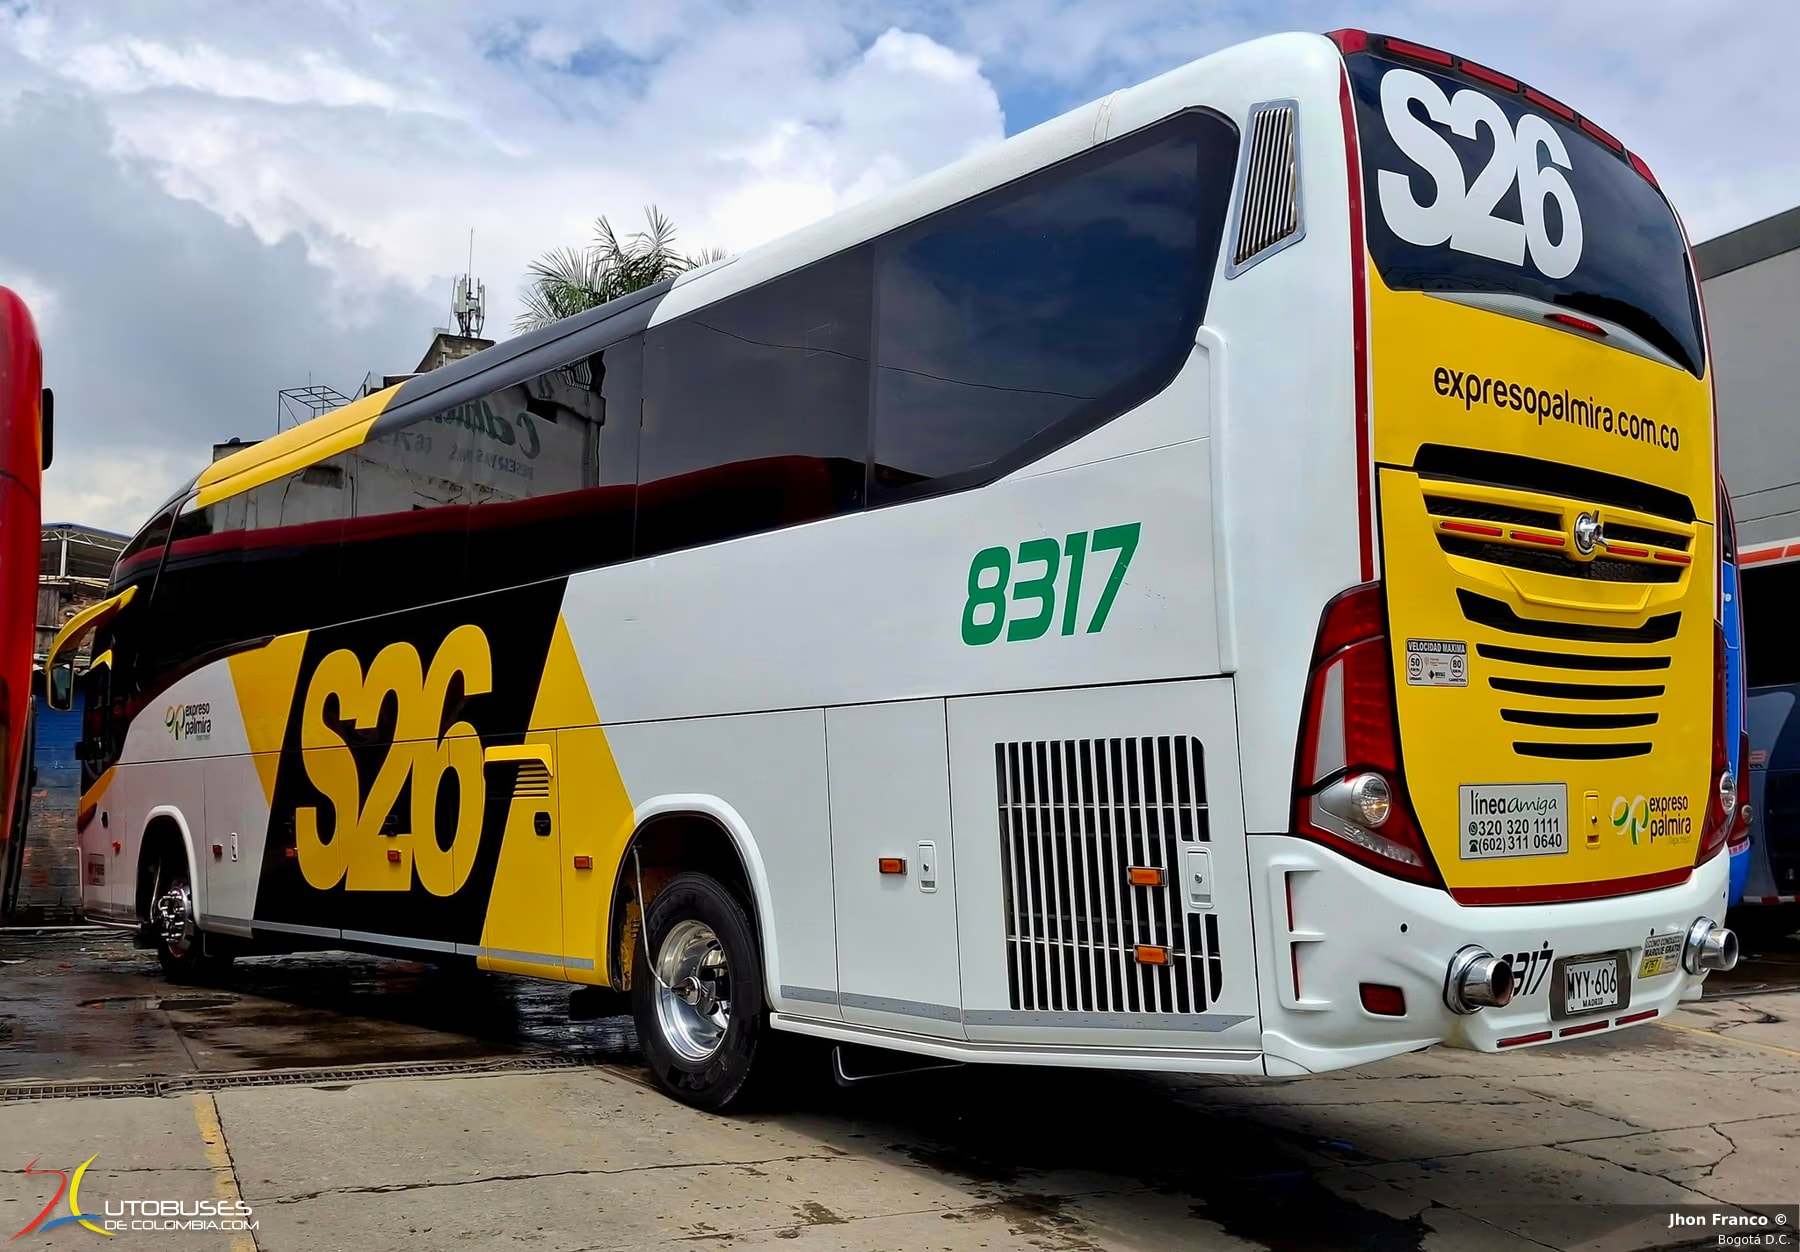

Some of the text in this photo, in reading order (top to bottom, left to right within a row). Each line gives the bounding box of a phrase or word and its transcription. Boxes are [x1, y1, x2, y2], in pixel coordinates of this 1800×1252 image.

[1377, 68, 1583, 279] S26
[1433, 366, 1680, 452] expresopalmira.com.co
[961, 522, 1141, 646] 8317
[1408, 641, 1466, 653] VELOCIDAD MAXIMA
[1410, 658, 1420, 667] 50
[1452, 659, 1462, 669] 80
[185, 703, 210, 720] expreso
[185, 718, 212, 740] palmira
[296, 624, 492, 897] S26
[1470, 789, 1558, 816] línea amiga
[1649, 795, 1689, 817] expreso
[1478, 817, 1559, 836] 320 320 1111
[1650, 813, 1692, 844] palmira
[1478, 833, 1562, 855] (602) 311 0640
[1582, 998, 1604, 1008] MADRID
